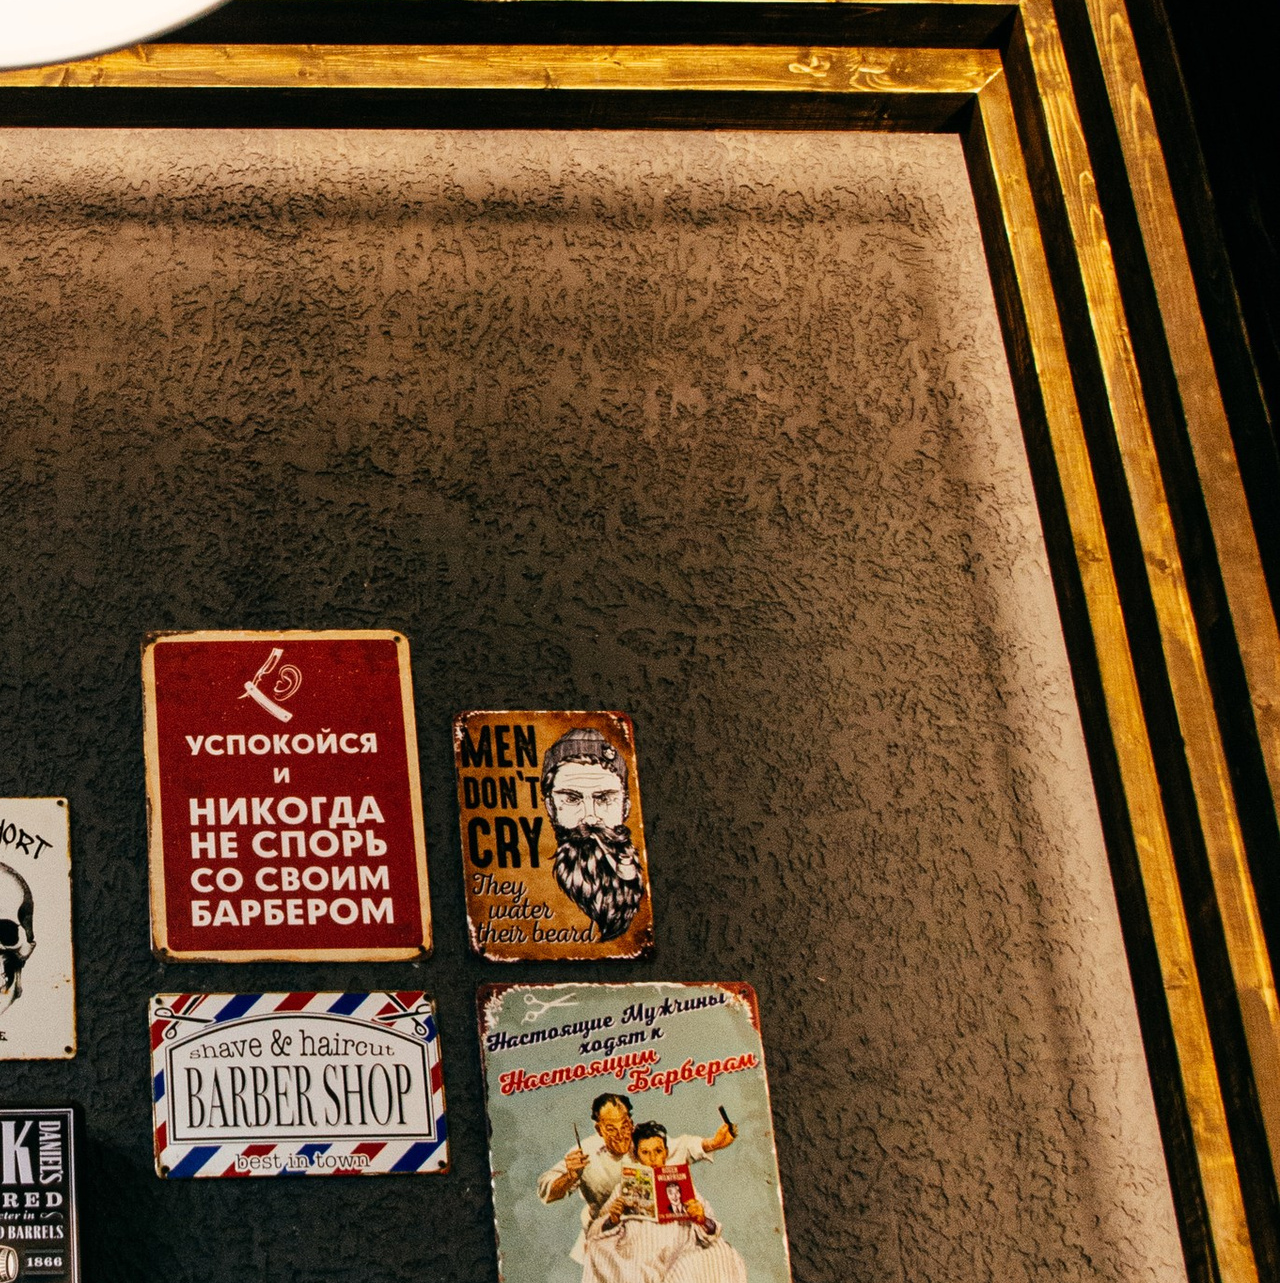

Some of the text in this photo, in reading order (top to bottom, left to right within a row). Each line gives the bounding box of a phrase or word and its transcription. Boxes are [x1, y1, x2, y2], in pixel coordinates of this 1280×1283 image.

[185, 727, 378, 756] УСПОКОЙСЯ
[460, 724, 538, 768] MEN
[189, 795, 385, 829] НИКОГДА
[191, 830, 388, 859] НЕ СПОРЬ
[468, 816, 543, 869] CRY
[190, 865, 390, 893] СО СВОИМ
[472, 872, 527, 903] They
[191, 897, 394, 928] БАРБЕРОМ
[488, 898, 554, 920] water
[477, 919, 597, 945] their beard
[486, 993, 726, 1053] Настоящие Мужчины
[189, 1029, 396, 1060] shave & haircut
[579, 1027, 664, 1056] ходят к
[499, 1049, 660, 1095] Настоящим
[627, 1052, 760, 1095] Барберам
[183, 1063, 412, 1129] BARBER SHOP
[38, 1120, 63, 1184] DANIEL'S
[235, 1153, 370, 1171] best in town
[23, 1210, 35, 1220] in
[8, 1225, 64, 1239] BARRELS
[26, 1256, 63, 1267] 1866
